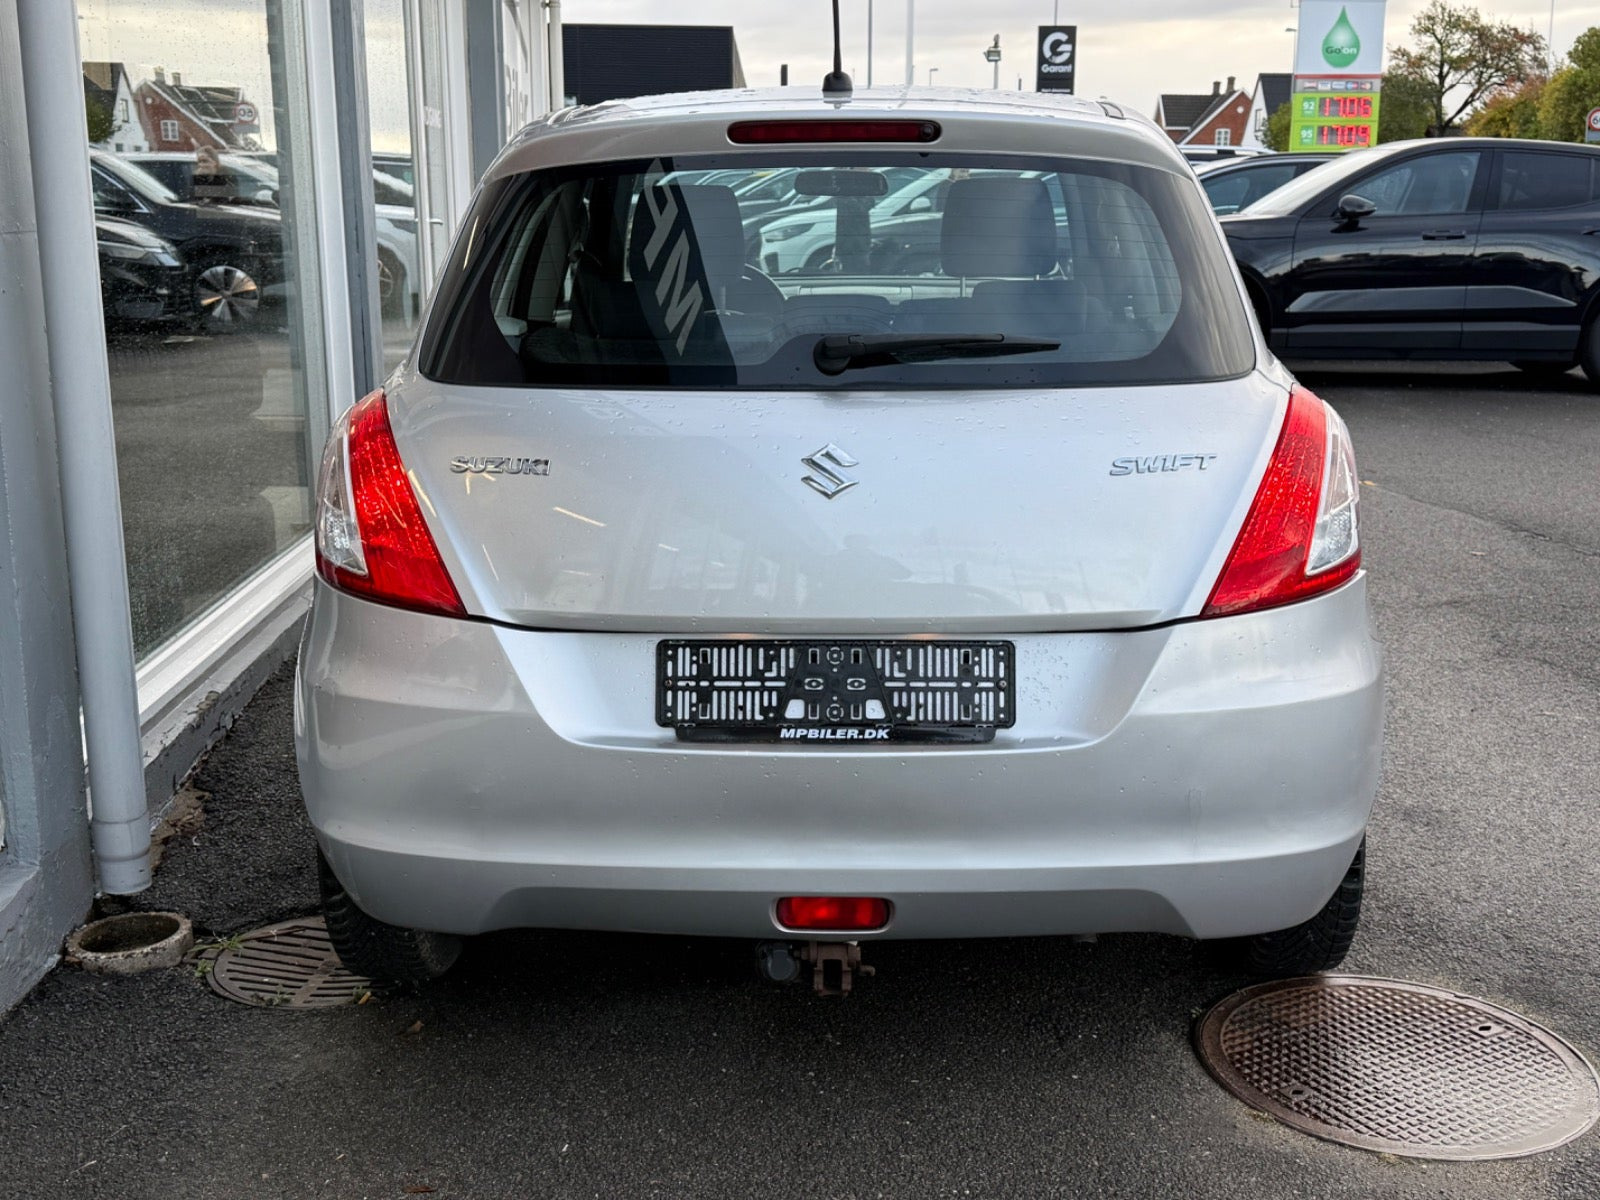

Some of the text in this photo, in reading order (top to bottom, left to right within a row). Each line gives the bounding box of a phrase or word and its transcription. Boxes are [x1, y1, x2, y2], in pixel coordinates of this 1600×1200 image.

[1041, 64, 1072, 73] Garant
[1303, 101, 1315, 111] 92
[1301, 130, 1313, 139] 95
[450, 456, 551, 476] SUZUKI
[1109, 453, 1217, 476] SWIFT
[779, 728, 891, 740] MPBILER.DK
